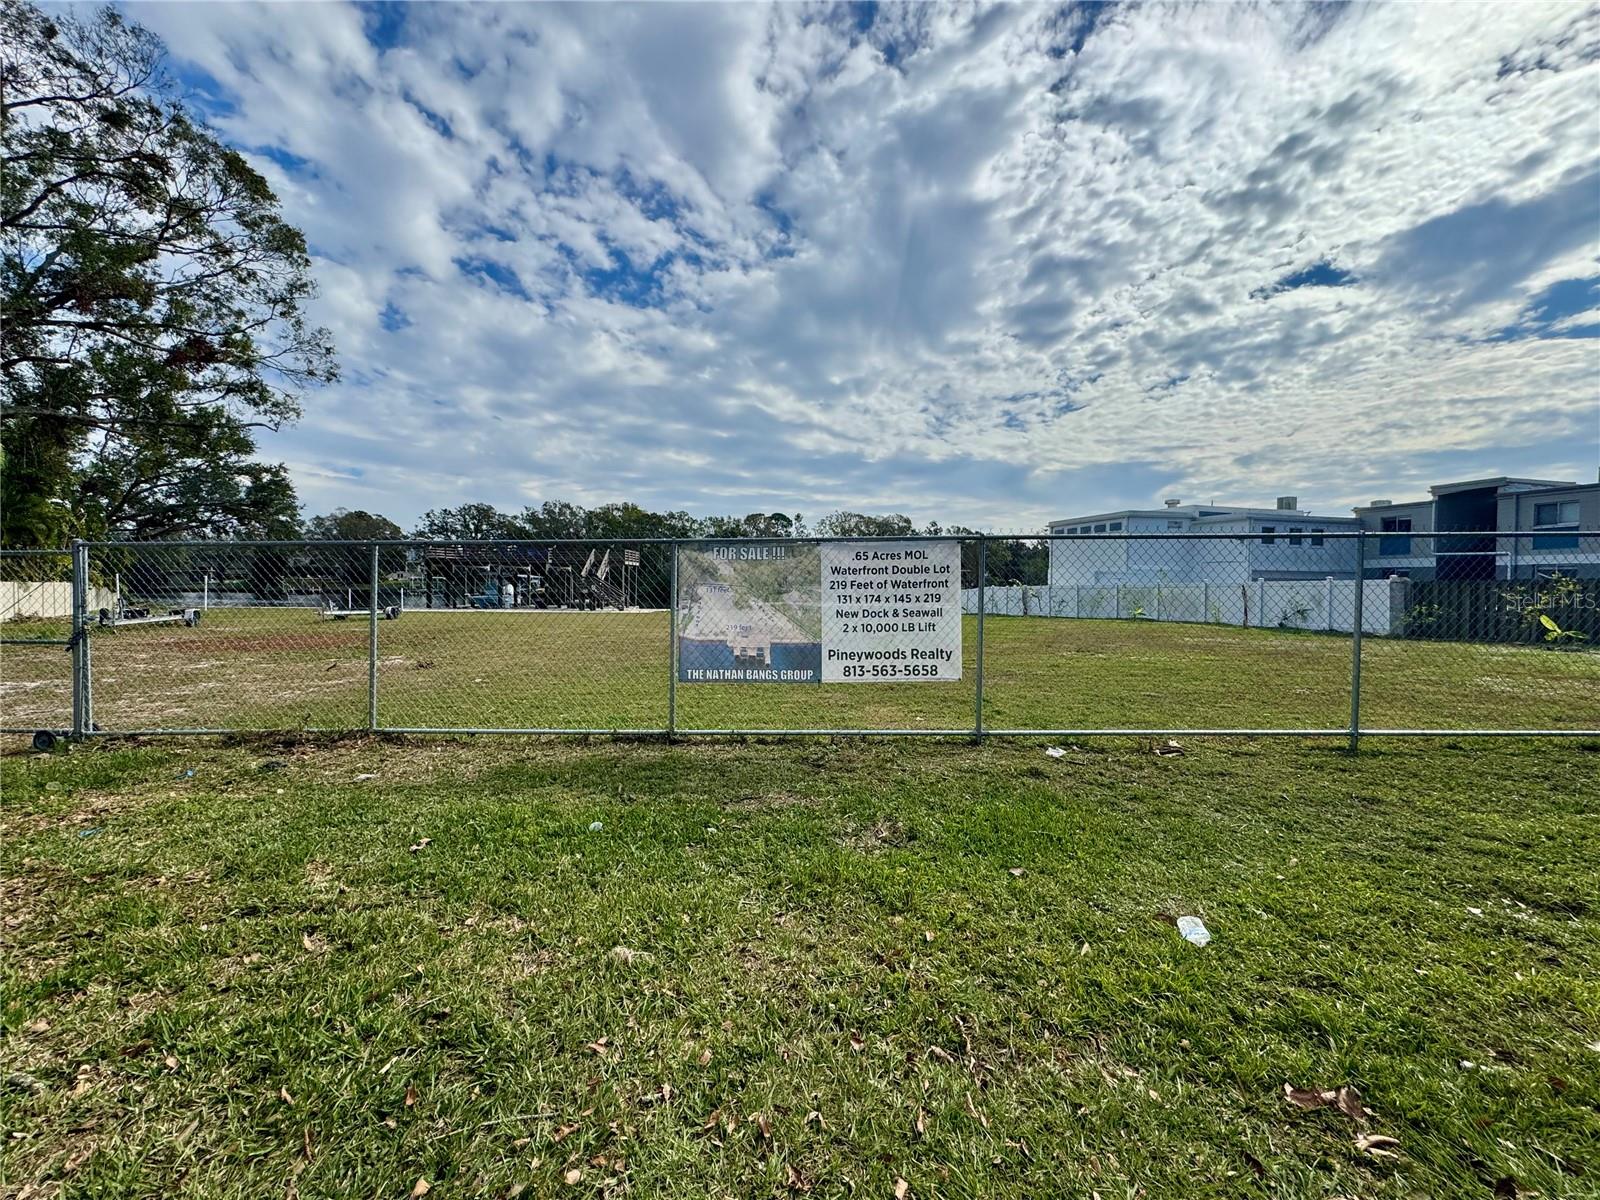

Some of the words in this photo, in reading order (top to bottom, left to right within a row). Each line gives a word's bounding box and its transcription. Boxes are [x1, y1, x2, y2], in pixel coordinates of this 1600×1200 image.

[713, 547, 736, 560] FOR
[740, 547, 769, 560] SALE
[772, 547, 785, 560] !!!
[852, 552, 868, 560] .65
[872, 552, 902, 560] Acres
[905, 551, 928, 560] MOL
[831, 566, 888, 575] Waterfront
[892, 565, 930, 574] Double
[934, 565, 950, 574] Lot
[830, 581, 847, 589] 219
[850, 581, 873, 589] Feet
[876, 580, 888, 589] of
[891, 579, 949, 588] Waterfront
[837, 595, 852, 604] 131
[855, 596, 861, 604] x
[865, 595, 881, 603] 174
[894, 594, 911, 603] 145
[924, 594, 941, 603] 219
[836, 609, 858, 618] New
[862, 609, 889, 618] Dock
[892, 609, 899, 618] &
[902, 608, 943, 617] Seawall
[843, 624, 849, 632] 2
[861, 623, 898, 634] 10,000
[902, 623, 914, 632] LB
[918, 622, 936, 632] Lift
[828, 649, 906, 662] Pineywoods
[911, 649, 952, 661] Realty
[687, 670, 704, 680] THE
[706, 670, 744, 680] NATHAN
[746, 670, 778, 680] BANGS
[781, 670, 814, 680] GROUP
[843, 665, 938, 677] 813-563-5658
